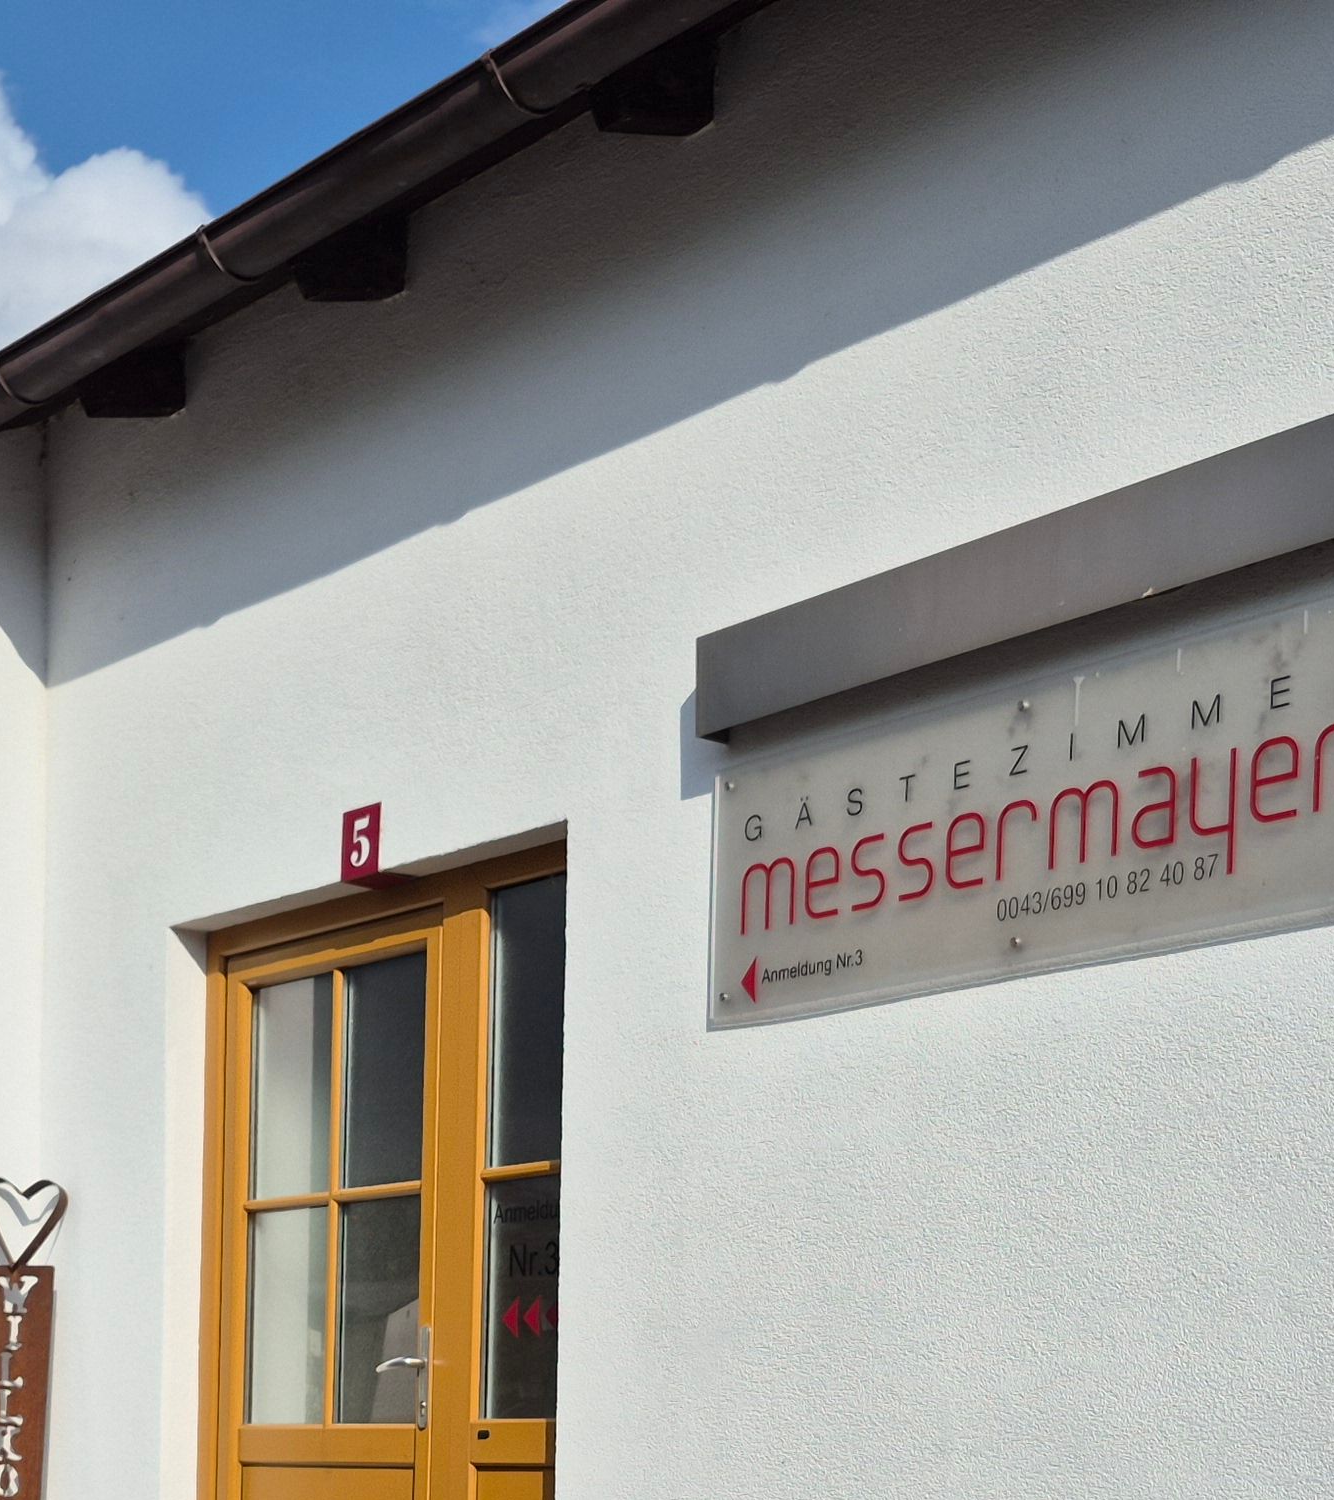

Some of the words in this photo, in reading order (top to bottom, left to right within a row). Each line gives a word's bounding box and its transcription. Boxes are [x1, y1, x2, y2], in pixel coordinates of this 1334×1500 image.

[349, 815, 371, 868] 5
[996, 882, 1086, 922] 0043/699
[1095, 875, 1118, 900] 10
[1126, 868, 1151, 895] 82
[1160, 861, 1184, 887] 40
[1193, 853, 1219, 881] 87
[761, 959, 832, 984] Anmeldung
[836, 949, 863, 970] Nr.3
[493, 1200, 558, 1225] Anmeldu
[509, 1240, 557, 1277] Nr.3
